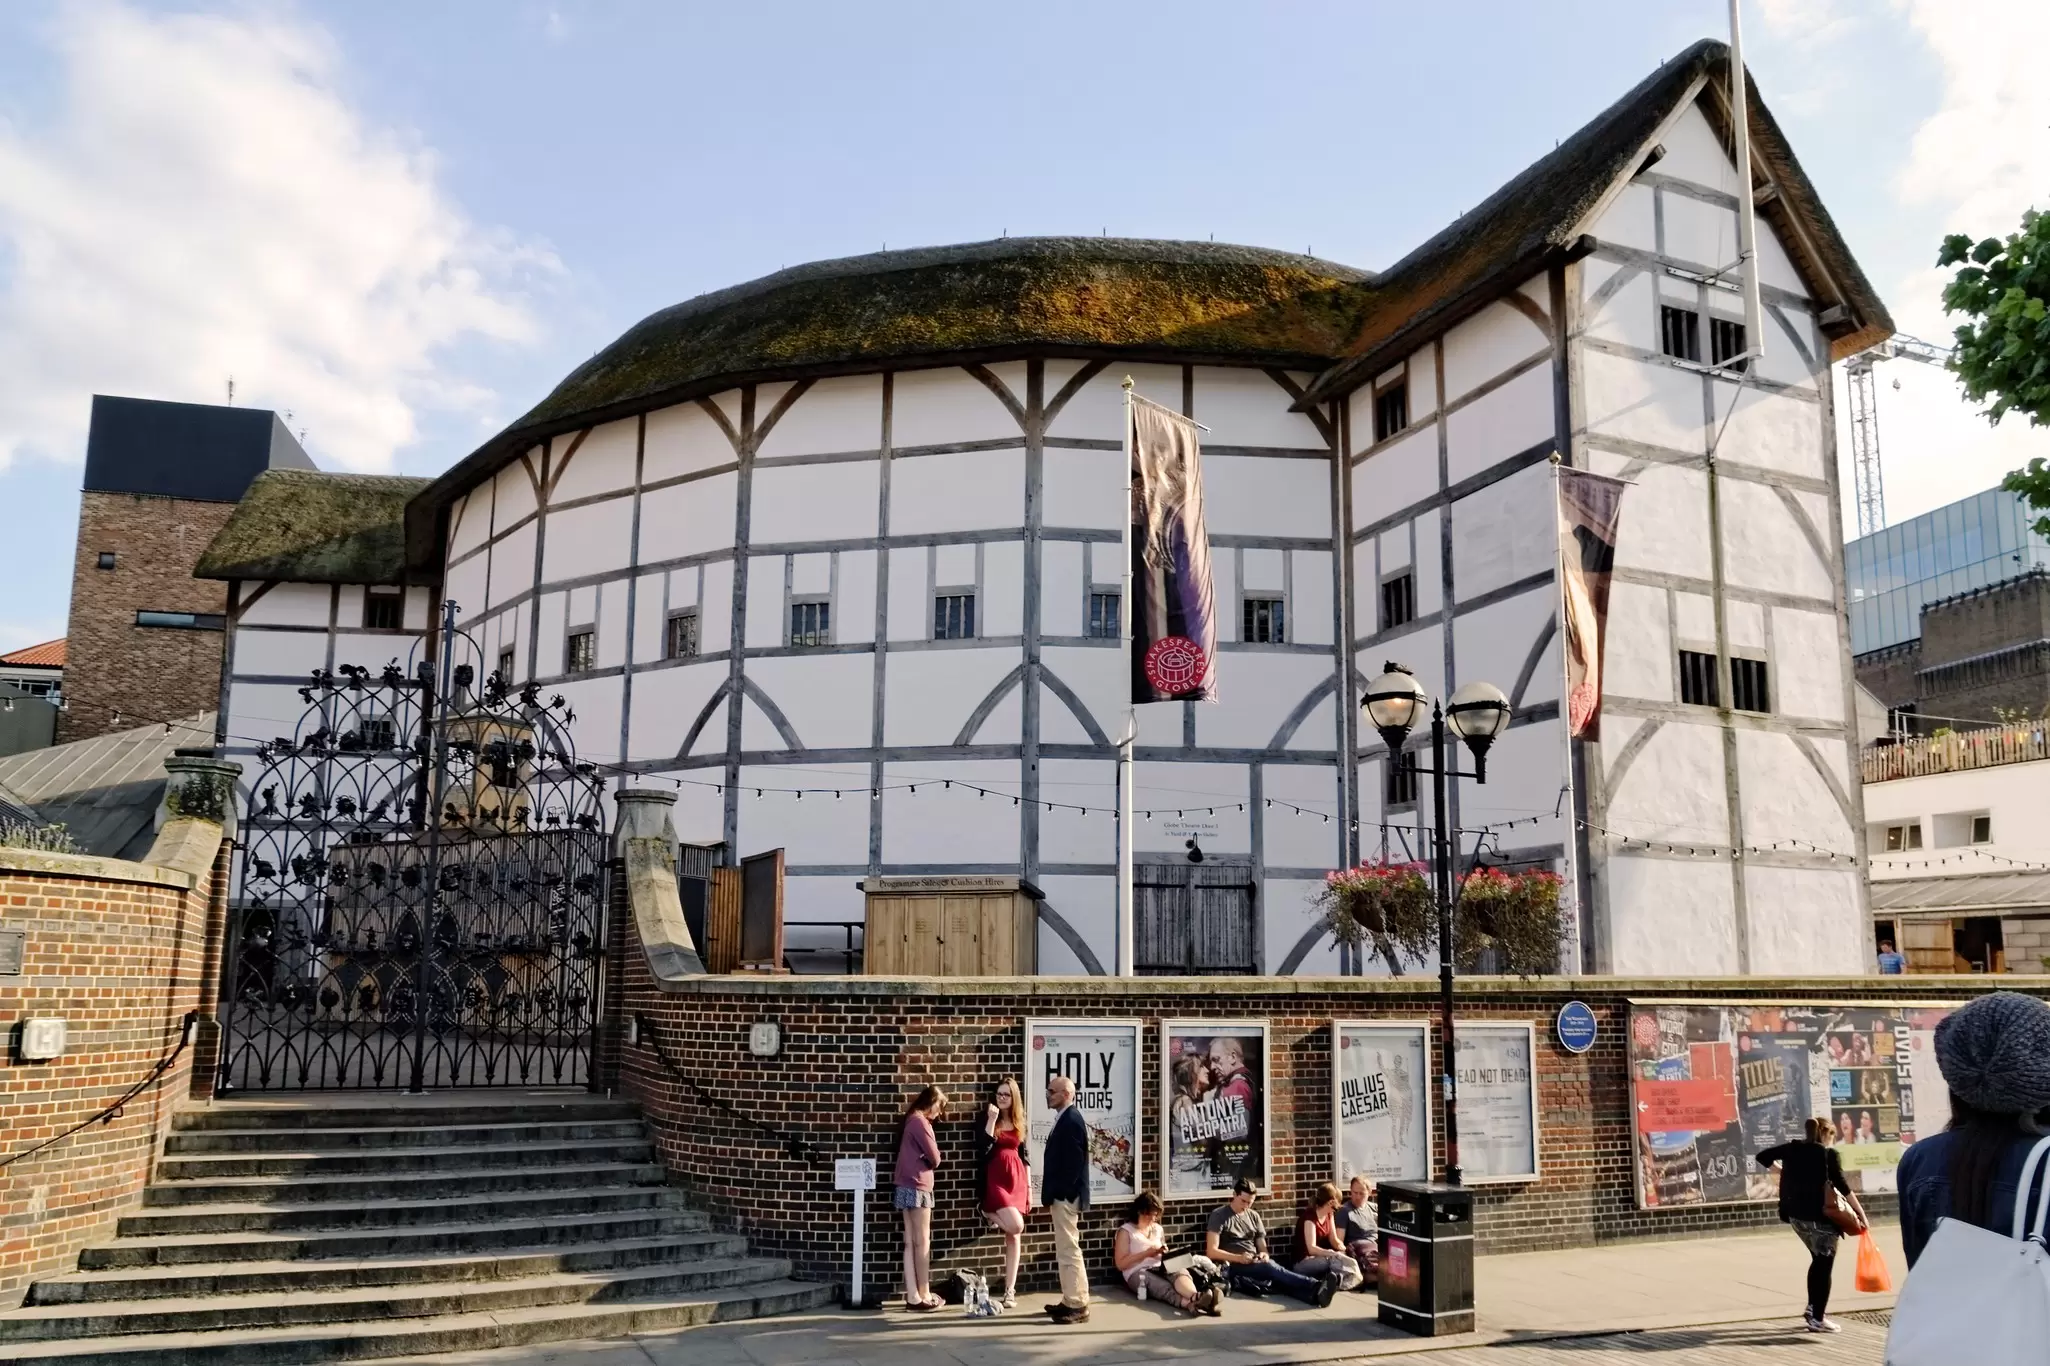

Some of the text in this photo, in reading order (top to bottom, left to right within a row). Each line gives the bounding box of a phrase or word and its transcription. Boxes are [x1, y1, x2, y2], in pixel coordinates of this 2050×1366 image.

[1146, 638, 1205, 675] SHAKESPEARE'S
[1156, 678, 1197, 692] GLOBE
[879, 879, 920, 889] Programme
[921, 878, 941, 887] Sales
[950, 878, 983, 887] Cushion
[1659, 1018, 1684, 1036] WORD
[1045, 1052, 1115, 1090] HOLY
[1457, 1068, 1526, 1084] EAD NOT DEAD
[1740, 1056, 1784, 1089] TITUS
[1341, 1072, 1385, 1100] JULIUS
[1180, 1095, 1234, 1128] ANTONY
[1233, 1095, 1246, 1115] AND
[1341, 1092, 1388, 1119] CAESAR
[1181, 1113, 1248, 1144] CLEOPATRA
[1706, 1154, 1738, 1179] 450
[1388, 1220, 1408, 1233] Litter
